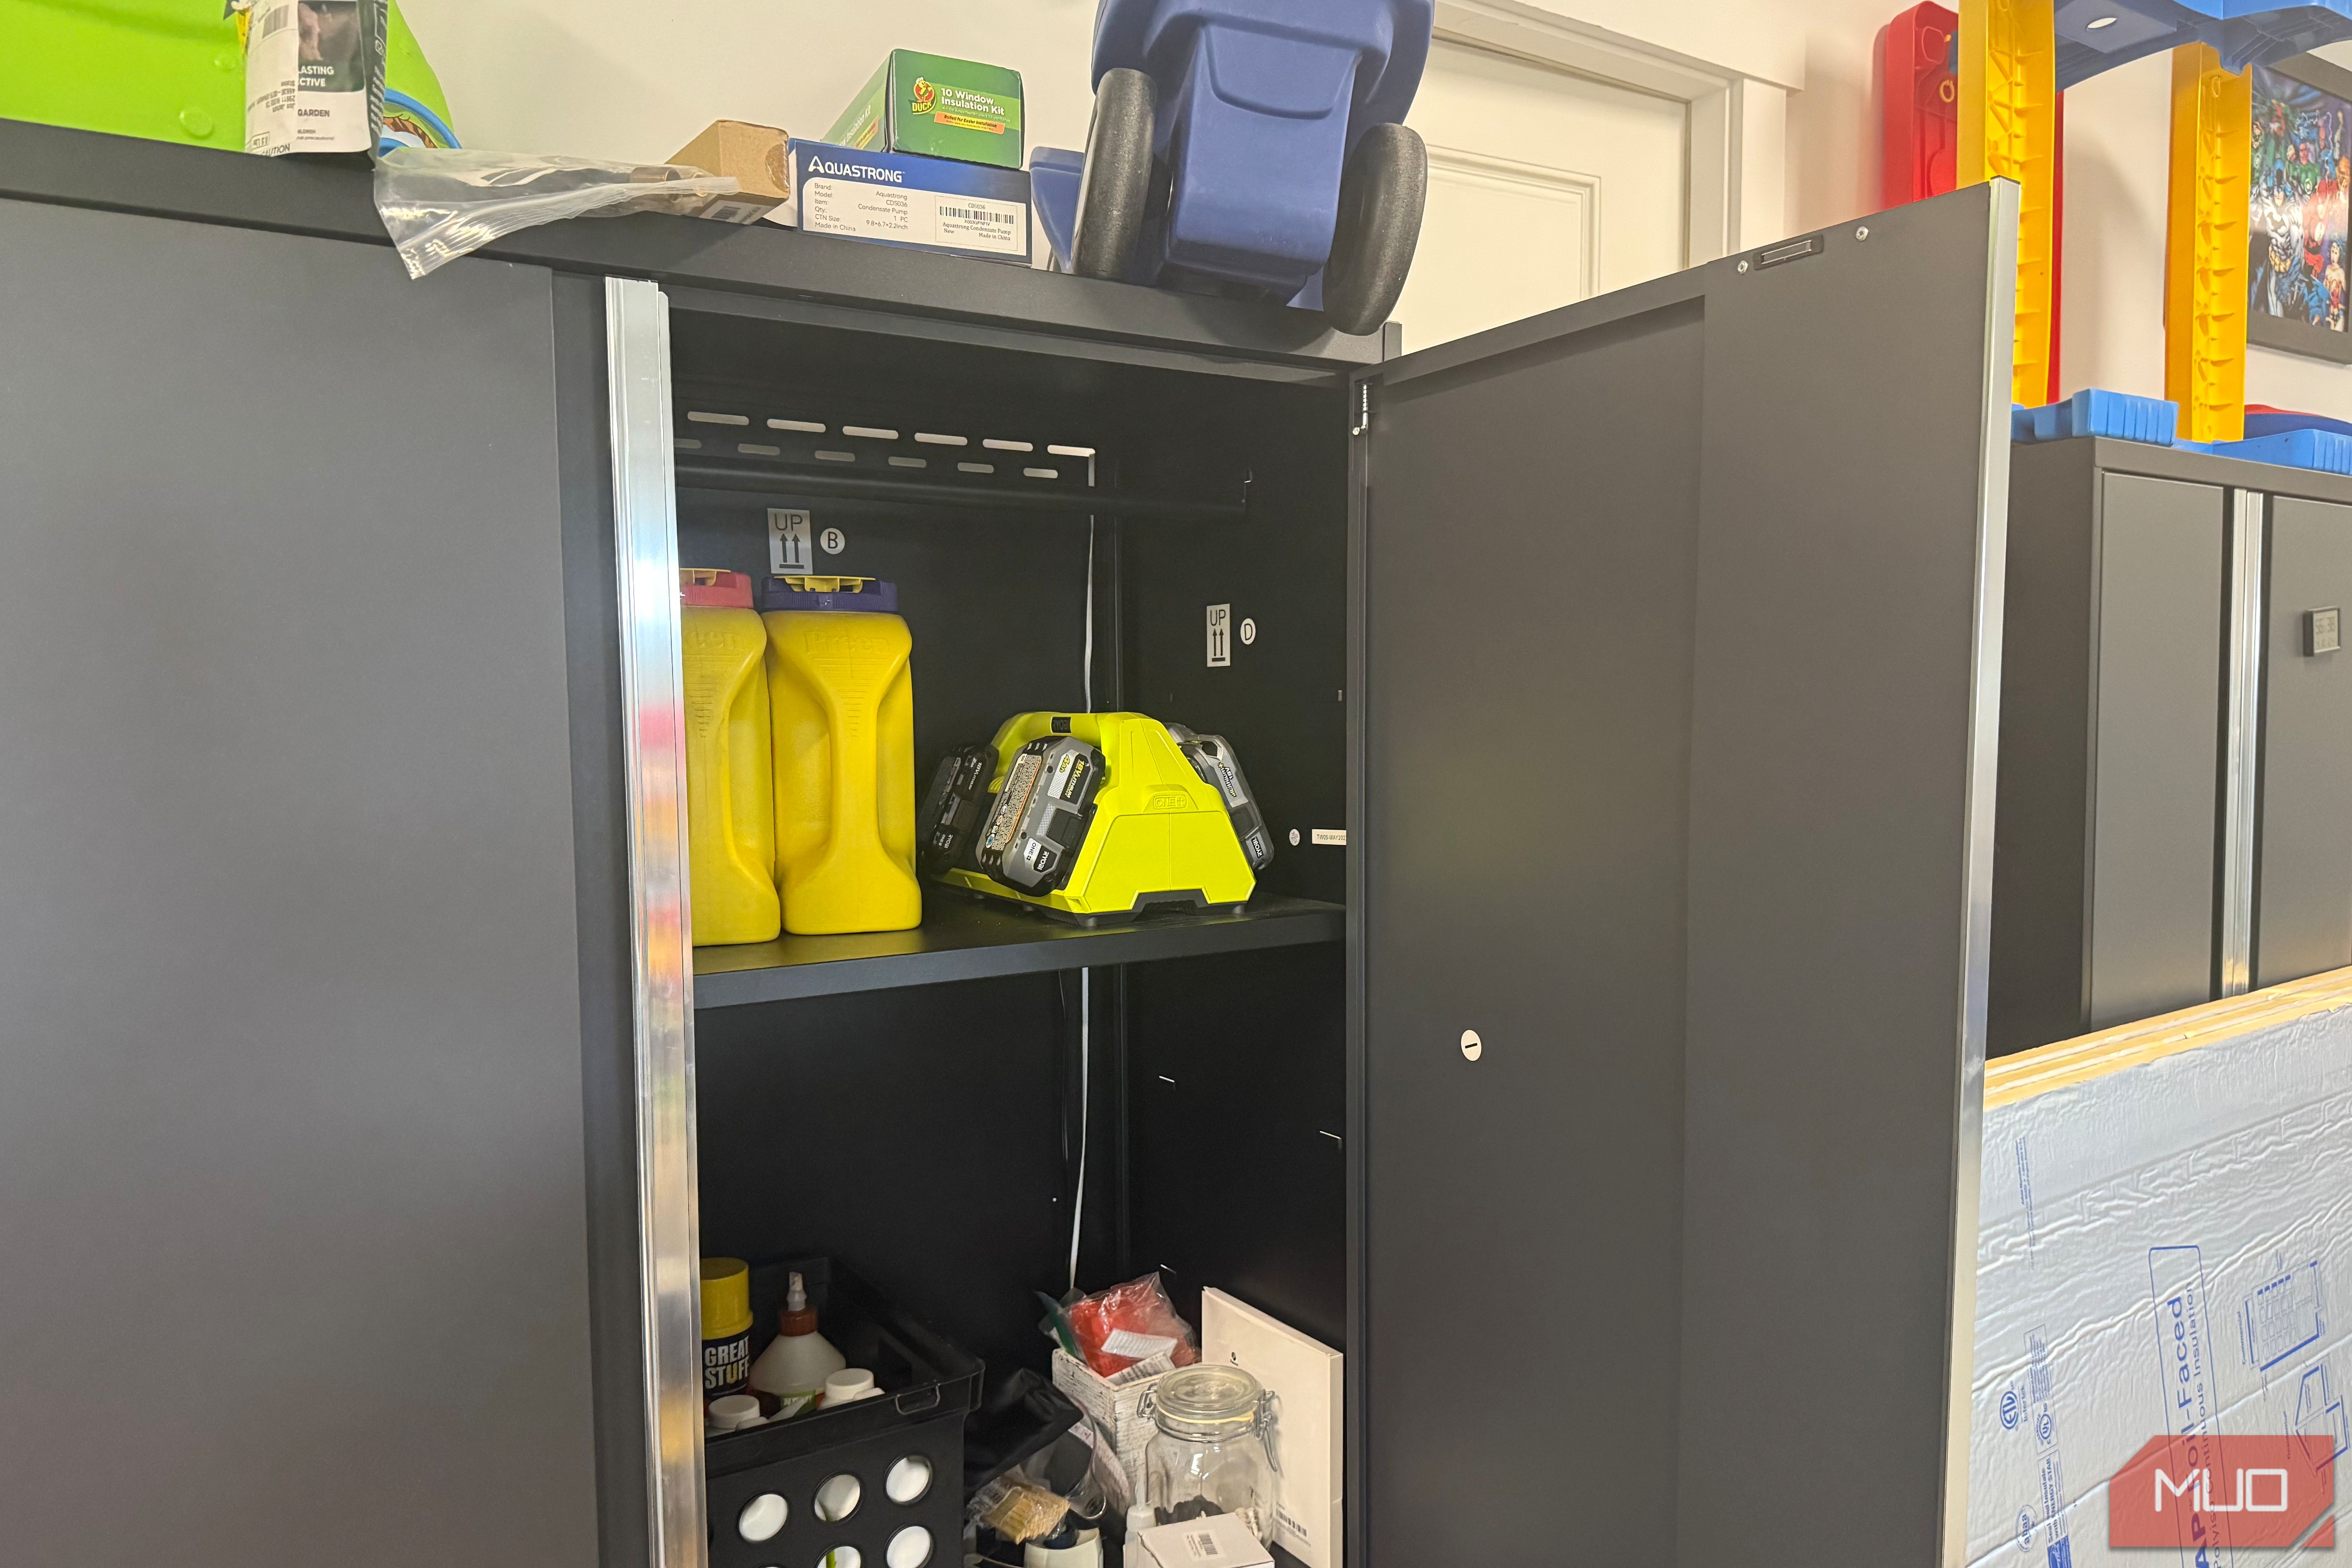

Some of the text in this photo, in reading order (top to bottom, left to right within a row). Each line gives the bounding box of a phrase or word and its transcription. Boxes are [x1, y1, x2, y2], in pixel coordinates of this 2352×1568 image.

[298, 78, 326, 87] CTIVE
[912, 100, 932, 111] DUCK
[941, 88, 994, 105] 10 Window
[298, 109, 330, 117] GARDEN
[941, 97, 989, 112] Insulation
[991, 106, 1005, 115] Kit
[808, 155, 902, 183] AQUASTRONG
[876, 191, 908, 201] Aquastrong
[858, 203, 891, 212] Condensate
[943, 222, 969, 230] Aquastrong
[970, 225, 996, 233] Condensate
[775, 513, 803, 531] UP
[828, 531, 838, 549] B
[1210, 609, 1226, 626] UP
[1244, 623, 1253, 641] D
[1224, 766, 1234, 780] 18V
[1252, 836, 1264, 858] RYOBI
[1037, 851, 1050, 871] RYOBI
[2186, 1282, 2201, 1377] Insulation
[705, 1335, 749, 1366] GREAT
[705, 1355, 750, 1389] STUFF
[2167, 1296, 2201, 1492] Foil-Faced
[2042, 1419, 2049, 1434] UL
[2197, 1382, 2213, 1494] Continuous
